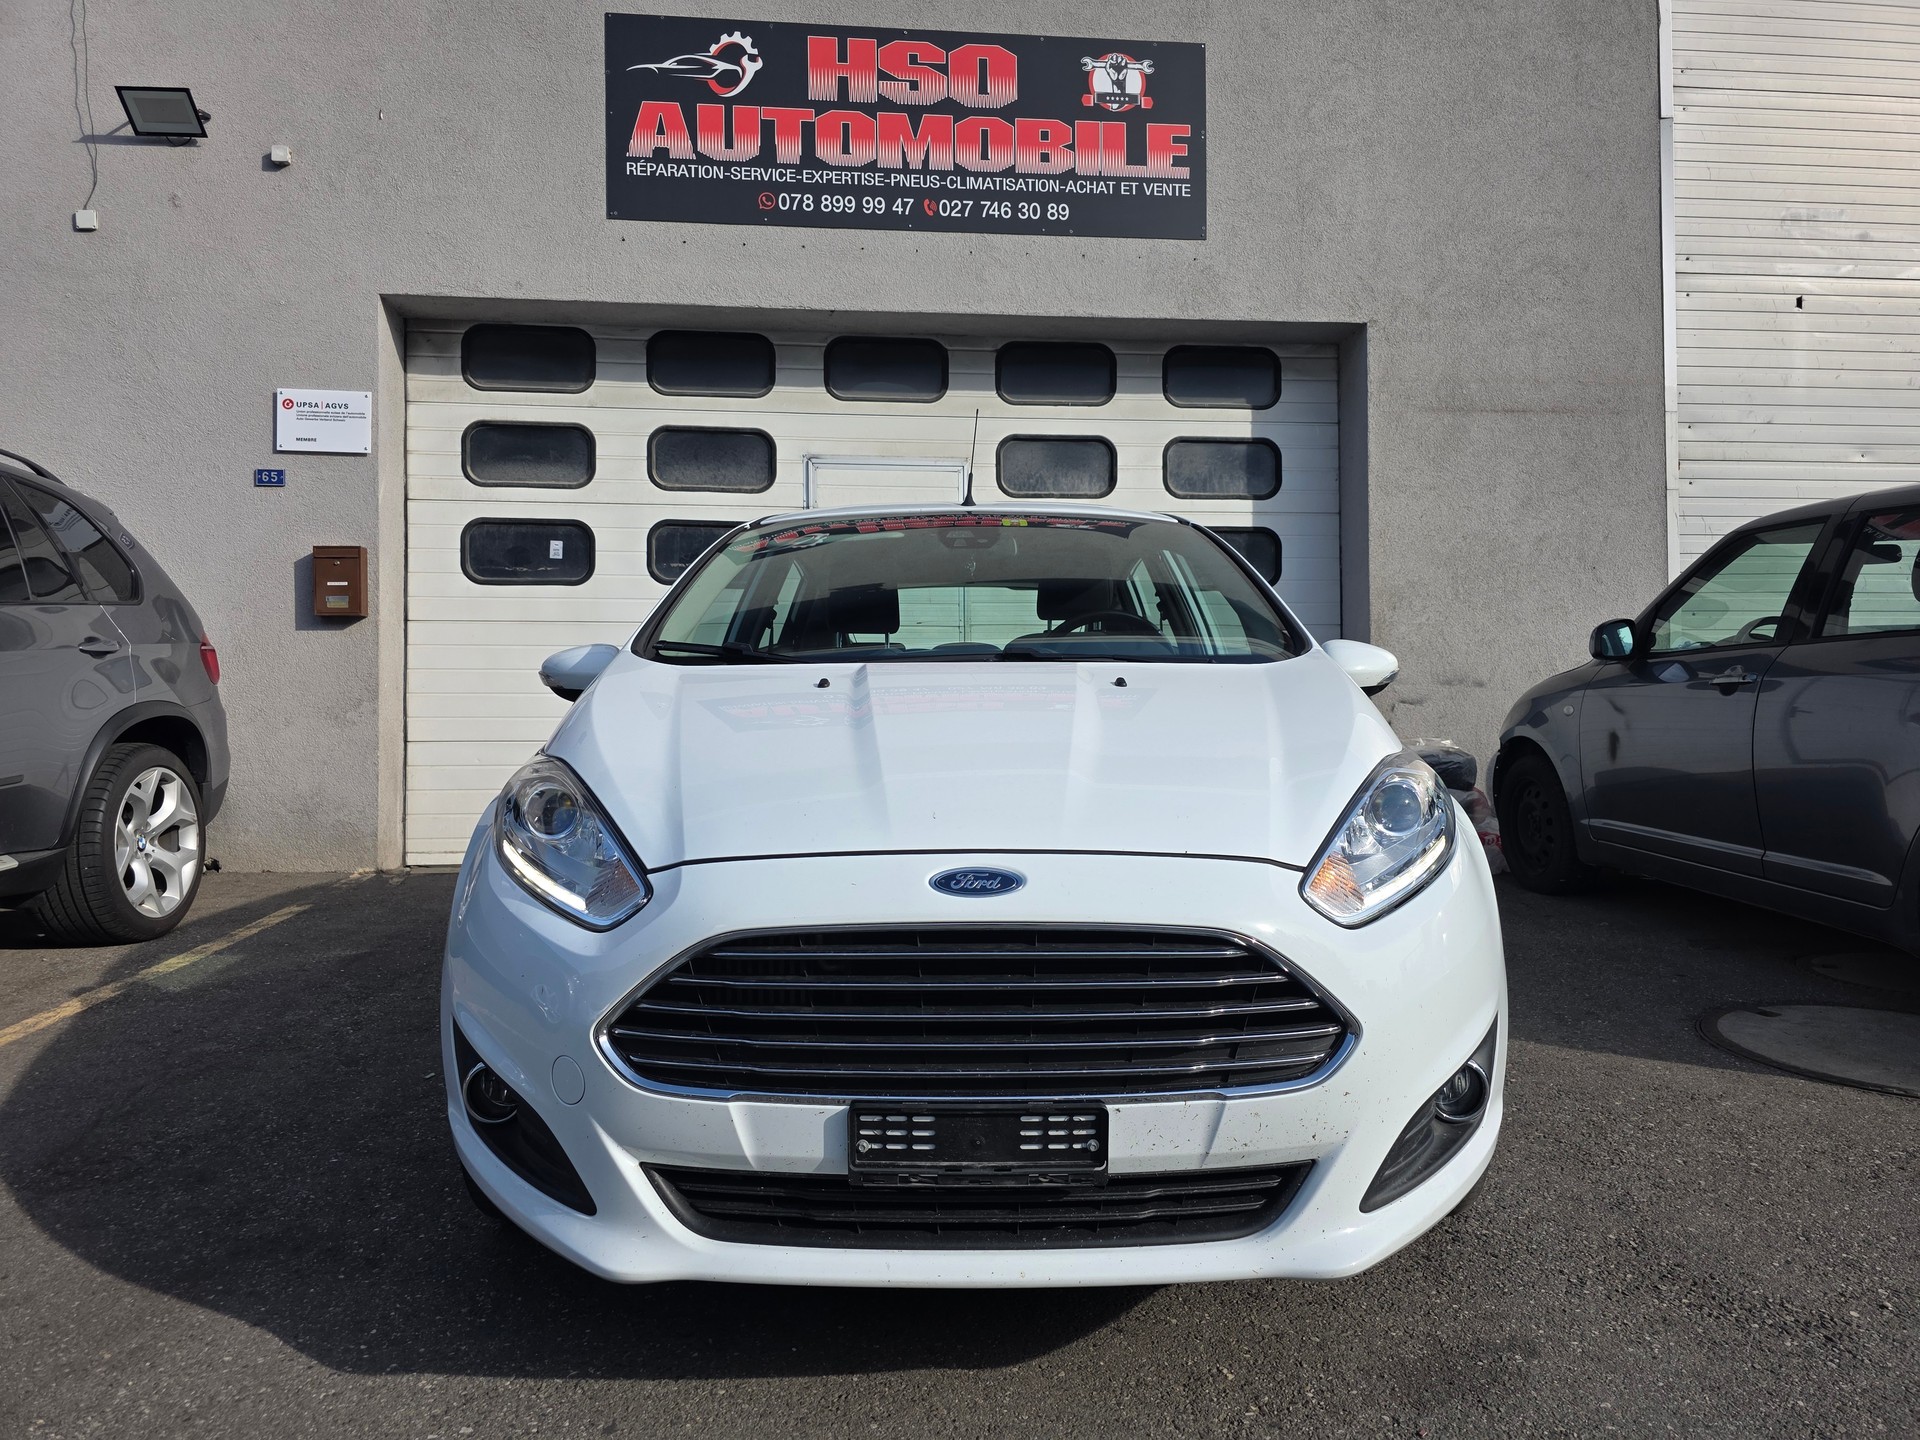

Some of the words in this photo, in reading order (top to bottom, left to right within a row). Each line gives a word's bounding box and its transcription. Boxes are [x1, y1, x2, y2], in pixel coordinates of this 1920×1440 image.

[807, 36, 1018, 108] HSO
[626, 100, 1191, 179] AUTOMOBILE
[1120, 182, 1139, 195] ET
[1143, 183, 1191, 197] VENTE
[778, 192, 814, 211] 078
[820, 194, 856, 214] 899
[862, 196, 886, 215] 99
[892, 198, 915, 215] 47
[938, 199, 974, 217] 027
[980, 201, 1012, 219] 746
[1018, 202, 1041, 220] 30
[1047, 203, 1070, 221] 89
[296, 401, 320, 409] UPSA
[325, 402, 349, 410] AGVS
[262, 471, 278, 482] 65
[950, 872, 1002, 889] Ford
